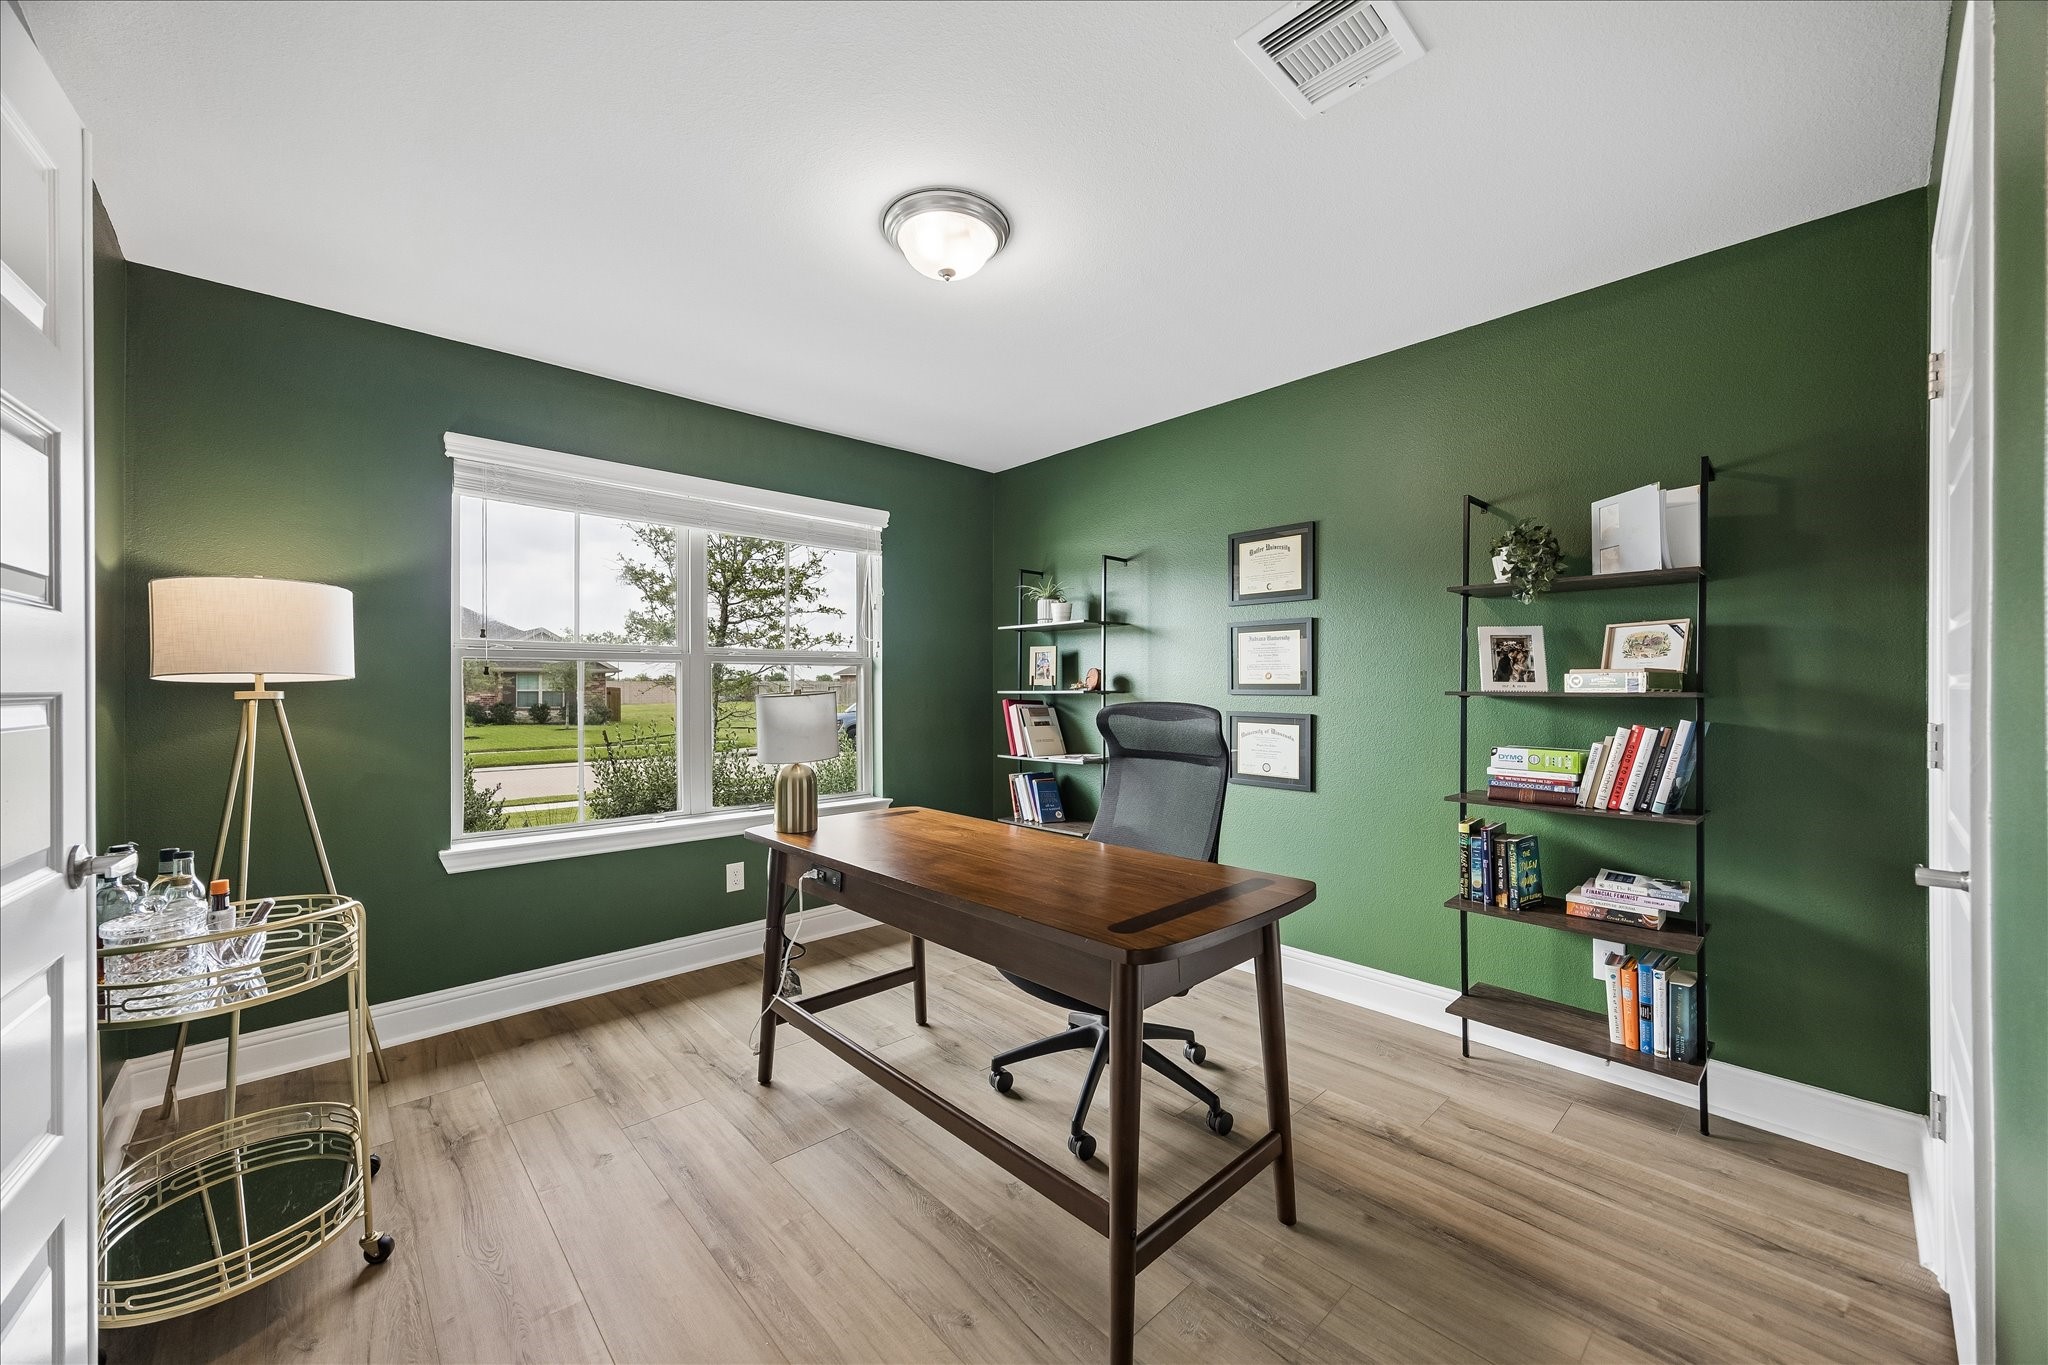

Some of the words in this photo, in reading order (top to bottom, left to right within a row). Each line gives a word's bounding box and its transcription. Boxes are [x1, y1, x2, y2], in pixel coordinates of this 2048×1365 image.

[1266, 544, 1290, 552] University
[1241, 729, 1264, 738] University
[1625, 744, 1634, 763] GOOD
[1621, 766, 1628, 774] TO
[1600, 770, 1614, 792] Habits
[1614, 777, 1625, 798] GREAT
[1522, 850, 1530, 858] THE
[1520, 860, 1537, 873] STOLEN
[1586, 888, 1613, 898] FINANCIAL
[1614, 892, 1639, 902] FEMINIST
